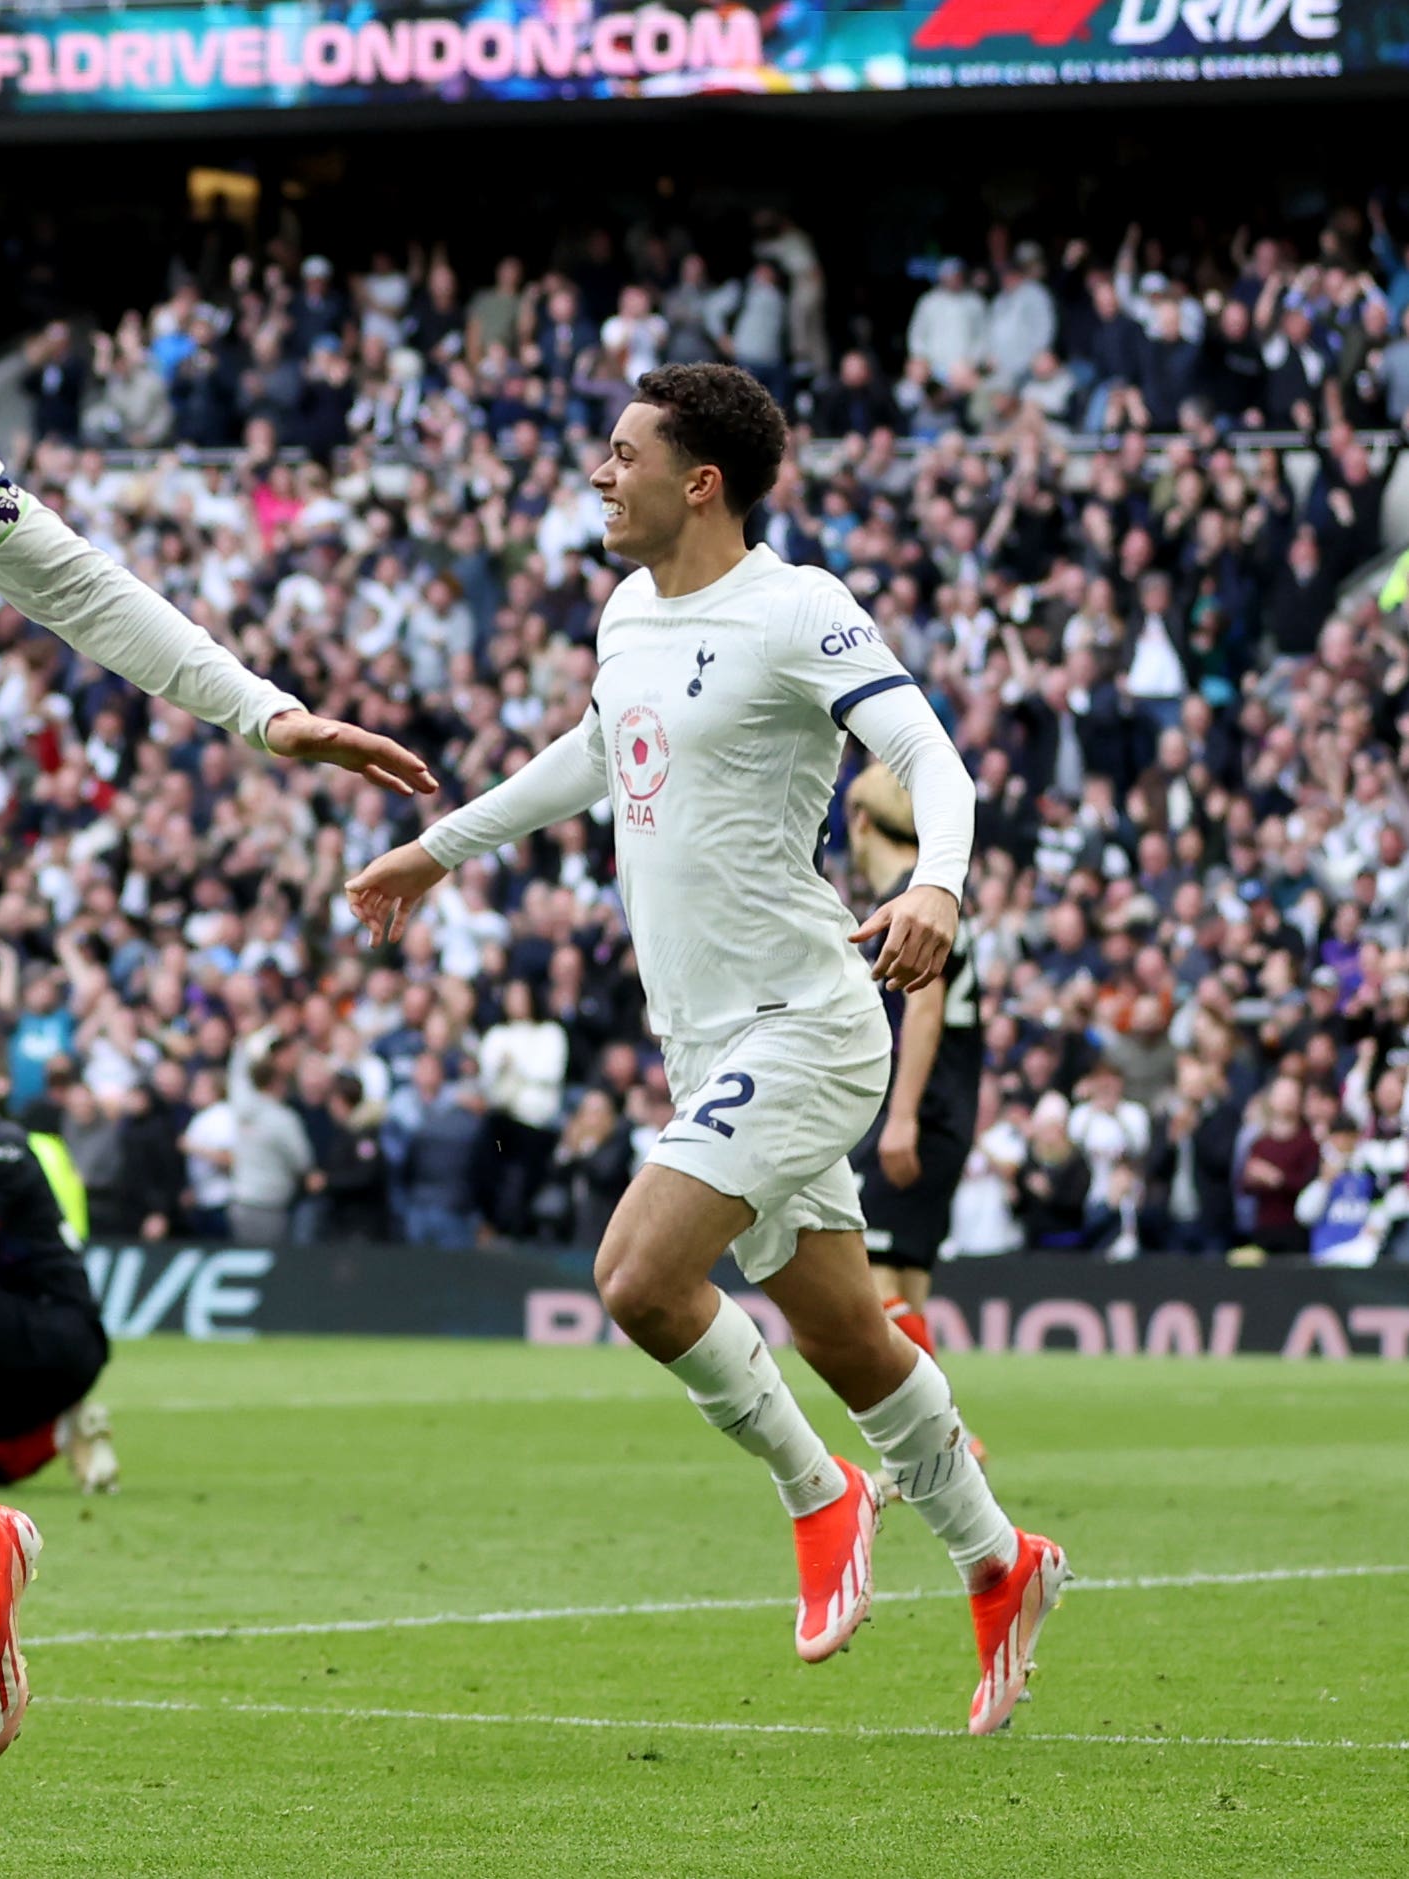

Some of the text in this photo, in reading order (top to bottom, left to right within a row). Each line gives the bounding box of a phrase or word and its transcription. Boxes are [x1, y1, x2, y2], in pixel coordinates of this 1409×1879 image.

[1109, 0, 1341, 45] DRIVE
[626, 804, 655, 828] AIA
[677, 1072, 755, 1139] 2
[85, 1247, 276, 1341] IVE
